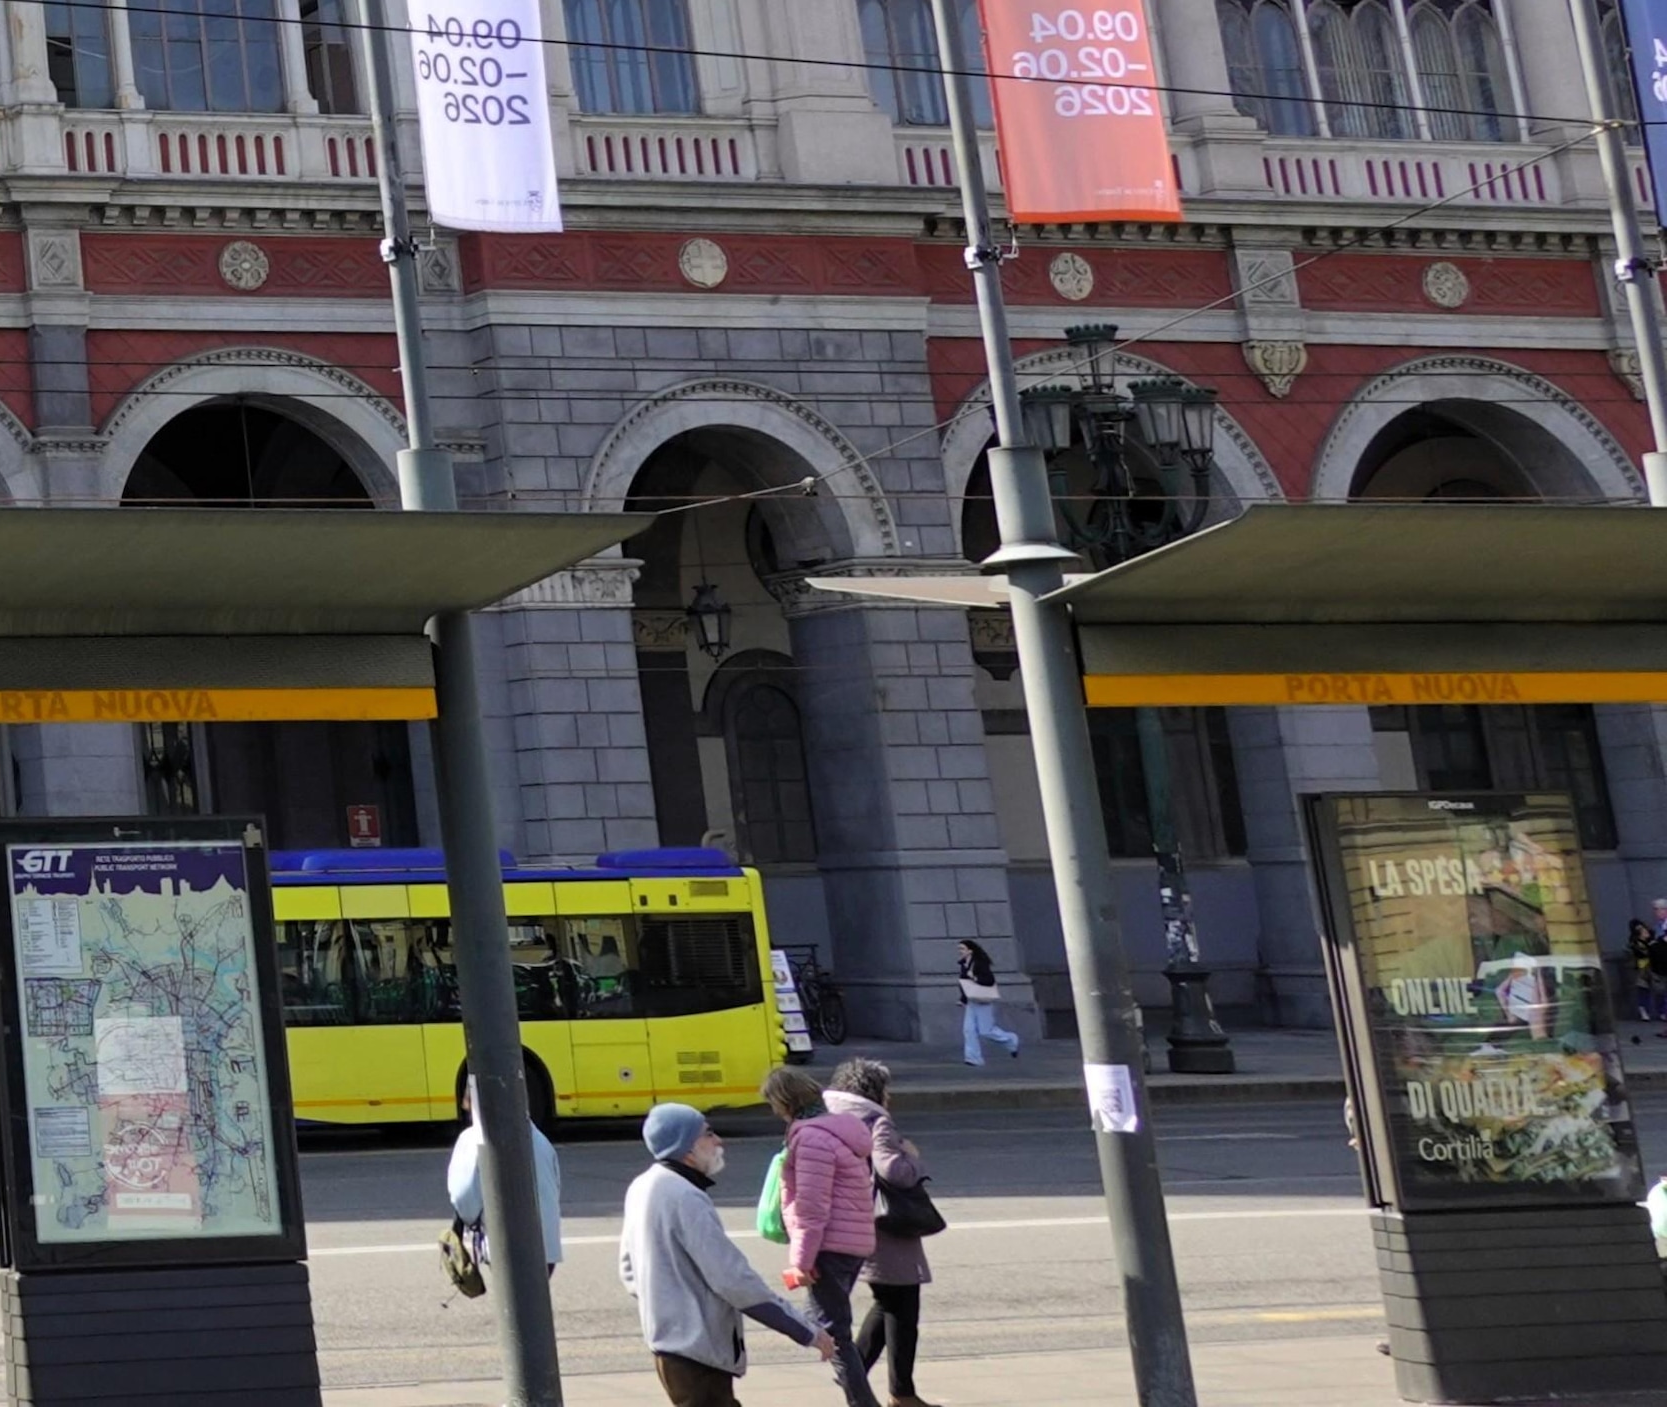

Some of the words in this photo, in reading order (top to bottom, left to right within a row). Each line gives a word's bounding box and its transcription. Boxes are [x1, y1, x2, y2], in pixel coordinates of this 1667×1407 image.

[1285, 676, 1394, 702] PORTA
[1411, 675, 1520, 699] NUOVA
[93, 692, 217, 718] NUOVA
[16, 850, 73, 872] GTT
[1369, 860, 1404, 896] LA
[1391, 977, 1478, 1016] ONLINE
[1407, 1082, 1436, 1119] DI
[1419, 1135, 1494, 1161] Cortilia
